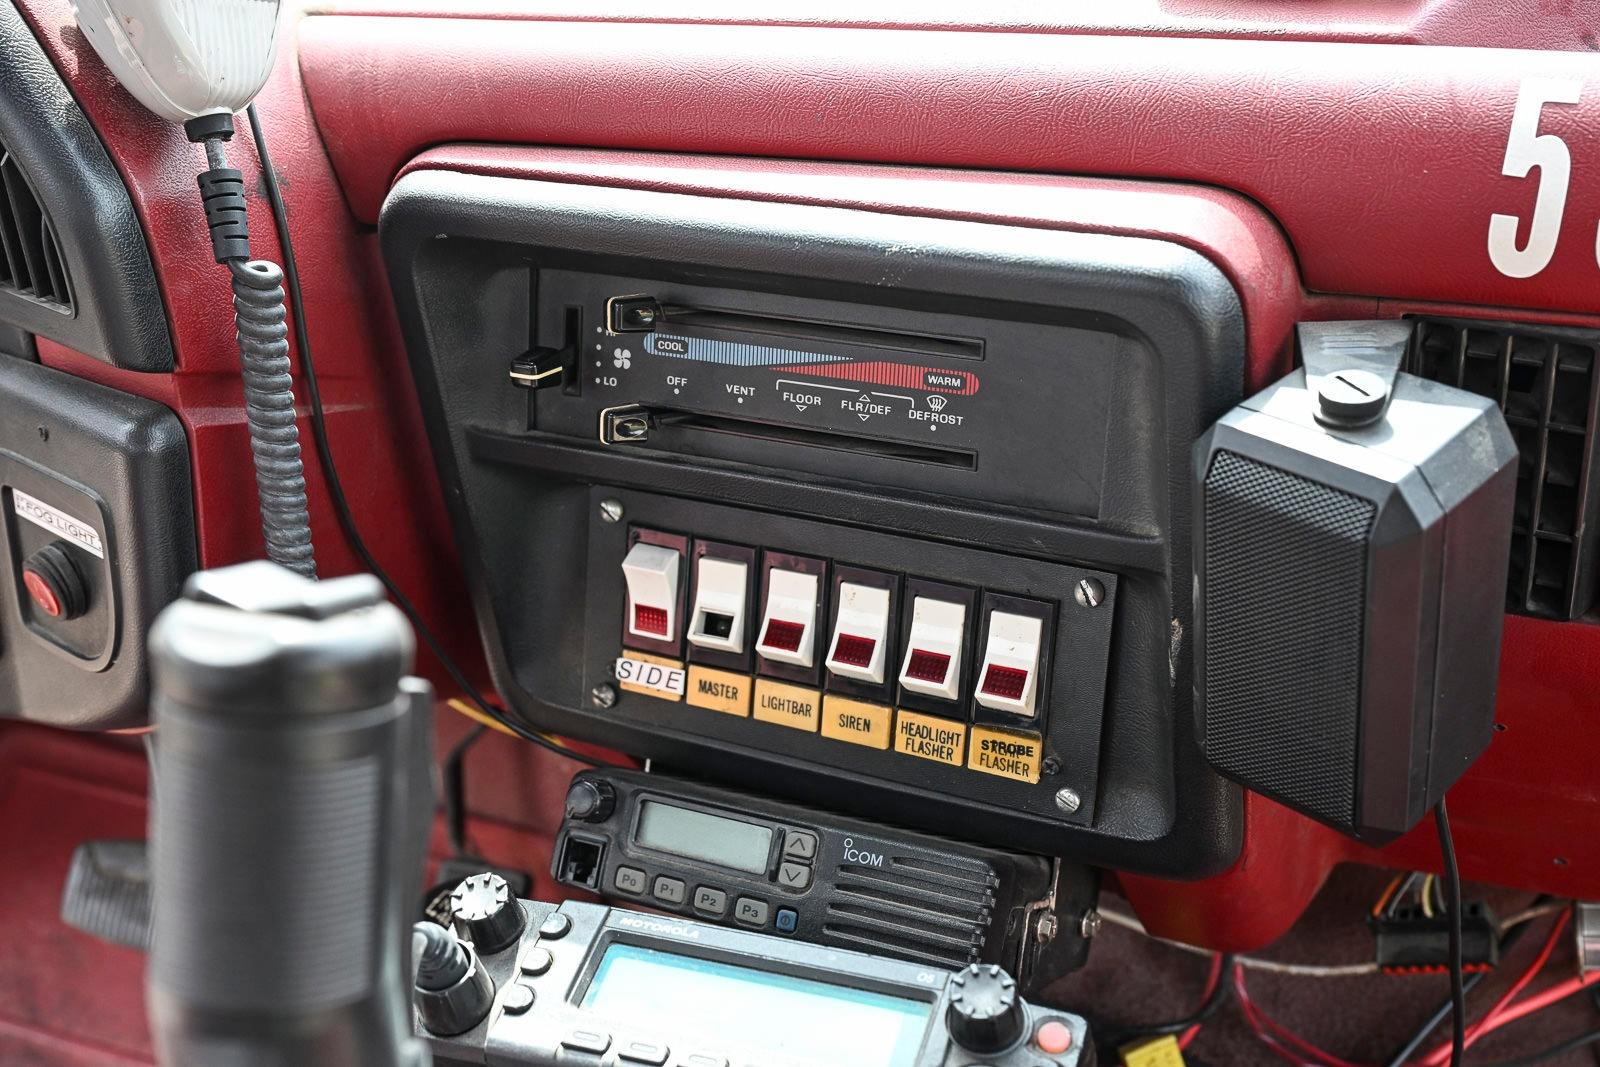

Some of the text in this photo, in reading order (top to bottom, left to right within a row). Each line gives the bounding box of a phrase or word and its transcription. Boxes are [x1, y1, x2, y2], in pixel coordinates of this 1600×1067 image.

[1487, 79, 1600, 278] 5
[657, 340, 685, 352] COOL
[603, 377, 618, 387] LO
[666, 376, 688, 387] OFF
[927, 374, 961, 388] WARM
[726, 384, 756, 397] VENT
[783, 392, 822, 406] FLOOR
[841, 400, 892, 416] FLR/DEF
[908, 409, 964, 426] DEFROST
[26, 502, 95, 545] FOG LIGHT
[617, 660, 684, 691] SIDE
[698, 679, 740, 701] MASTER
[761, 695, 813, 718] LIGHTBAR
[838, 714, 871, 733] SIREN
[901, 720, 962, 747] HEADLIGHT
[905, 737, 954, 762] FLASHER
[981, 739, 1034, 758] STROBE
[980, 752, 1030, 777] FLASHER
[660, 883, 674, 896] P1
[700, 893, 717, 907] P2
[742, 904, 759, 918] P3
[620, 917, 700, 940] MOTOROLA
